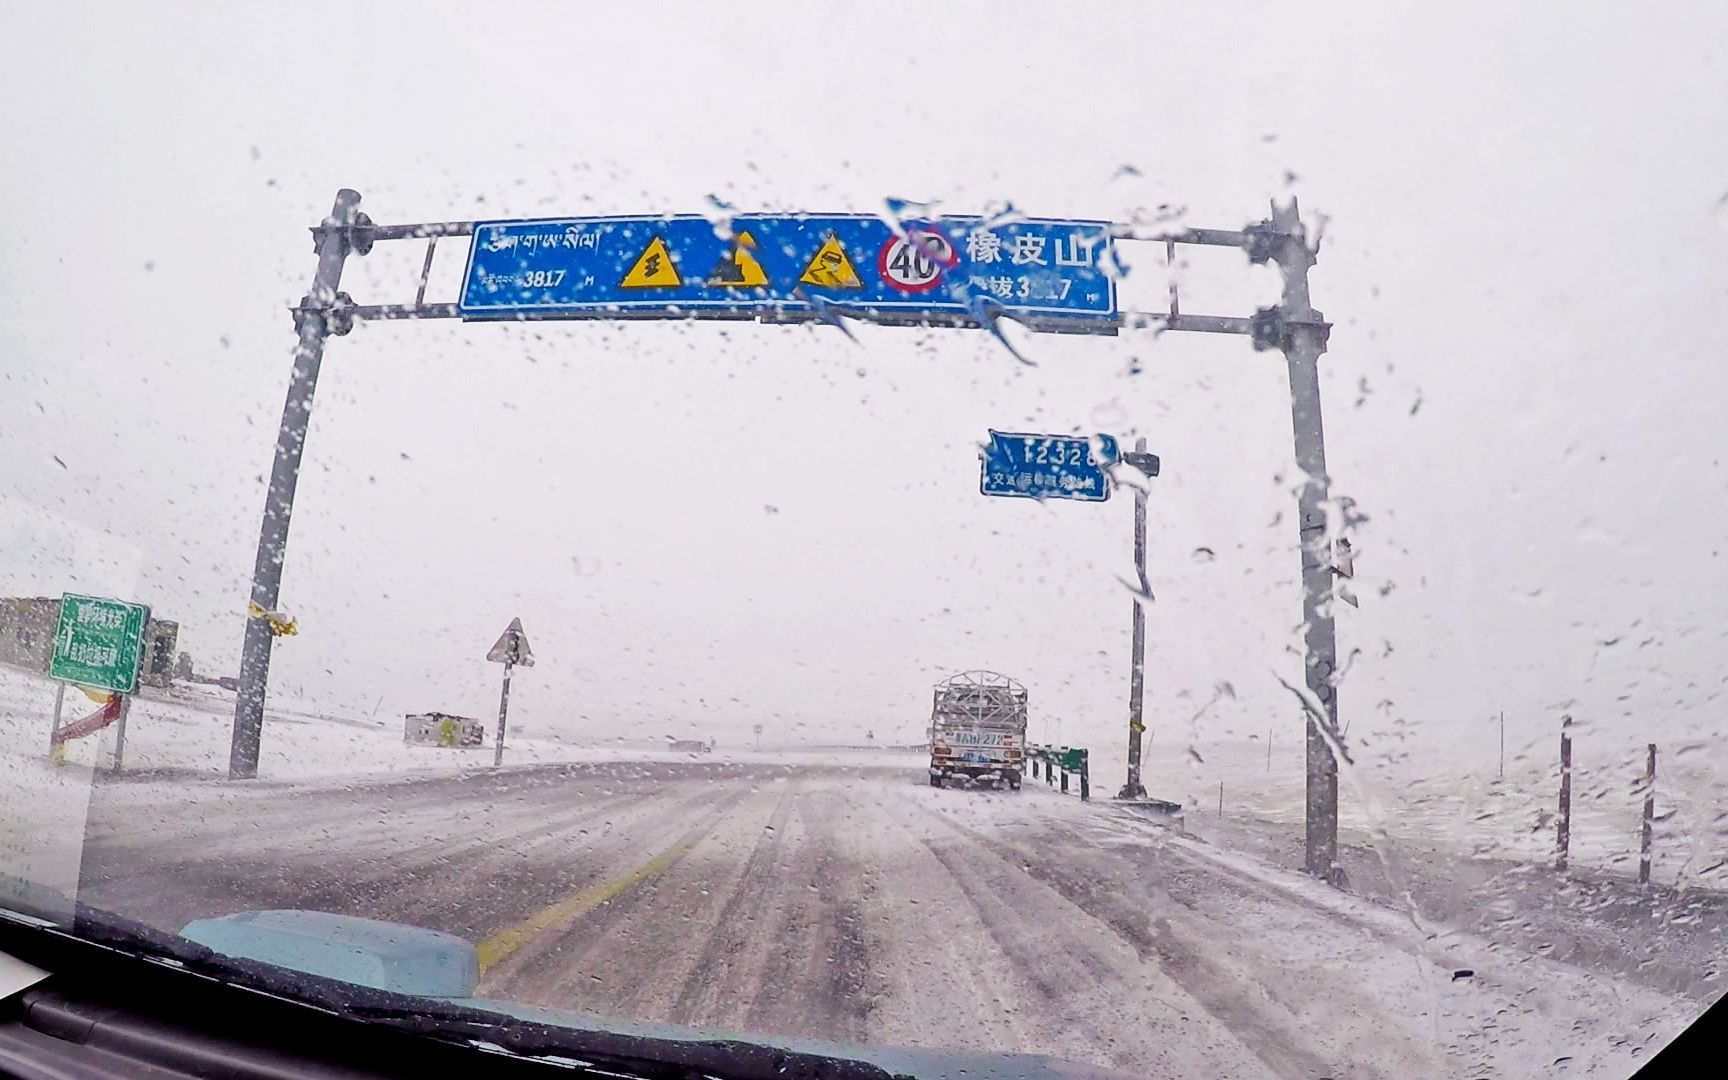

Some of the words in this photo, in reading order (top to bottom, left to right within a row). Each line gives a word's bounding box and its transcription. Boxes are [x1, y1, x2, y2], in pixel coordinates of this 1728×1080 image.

[889, 239, 939, 279] 40
[966, 231, 1093, 267] 橡皮山
[523, 270, 566, 288] 3817
